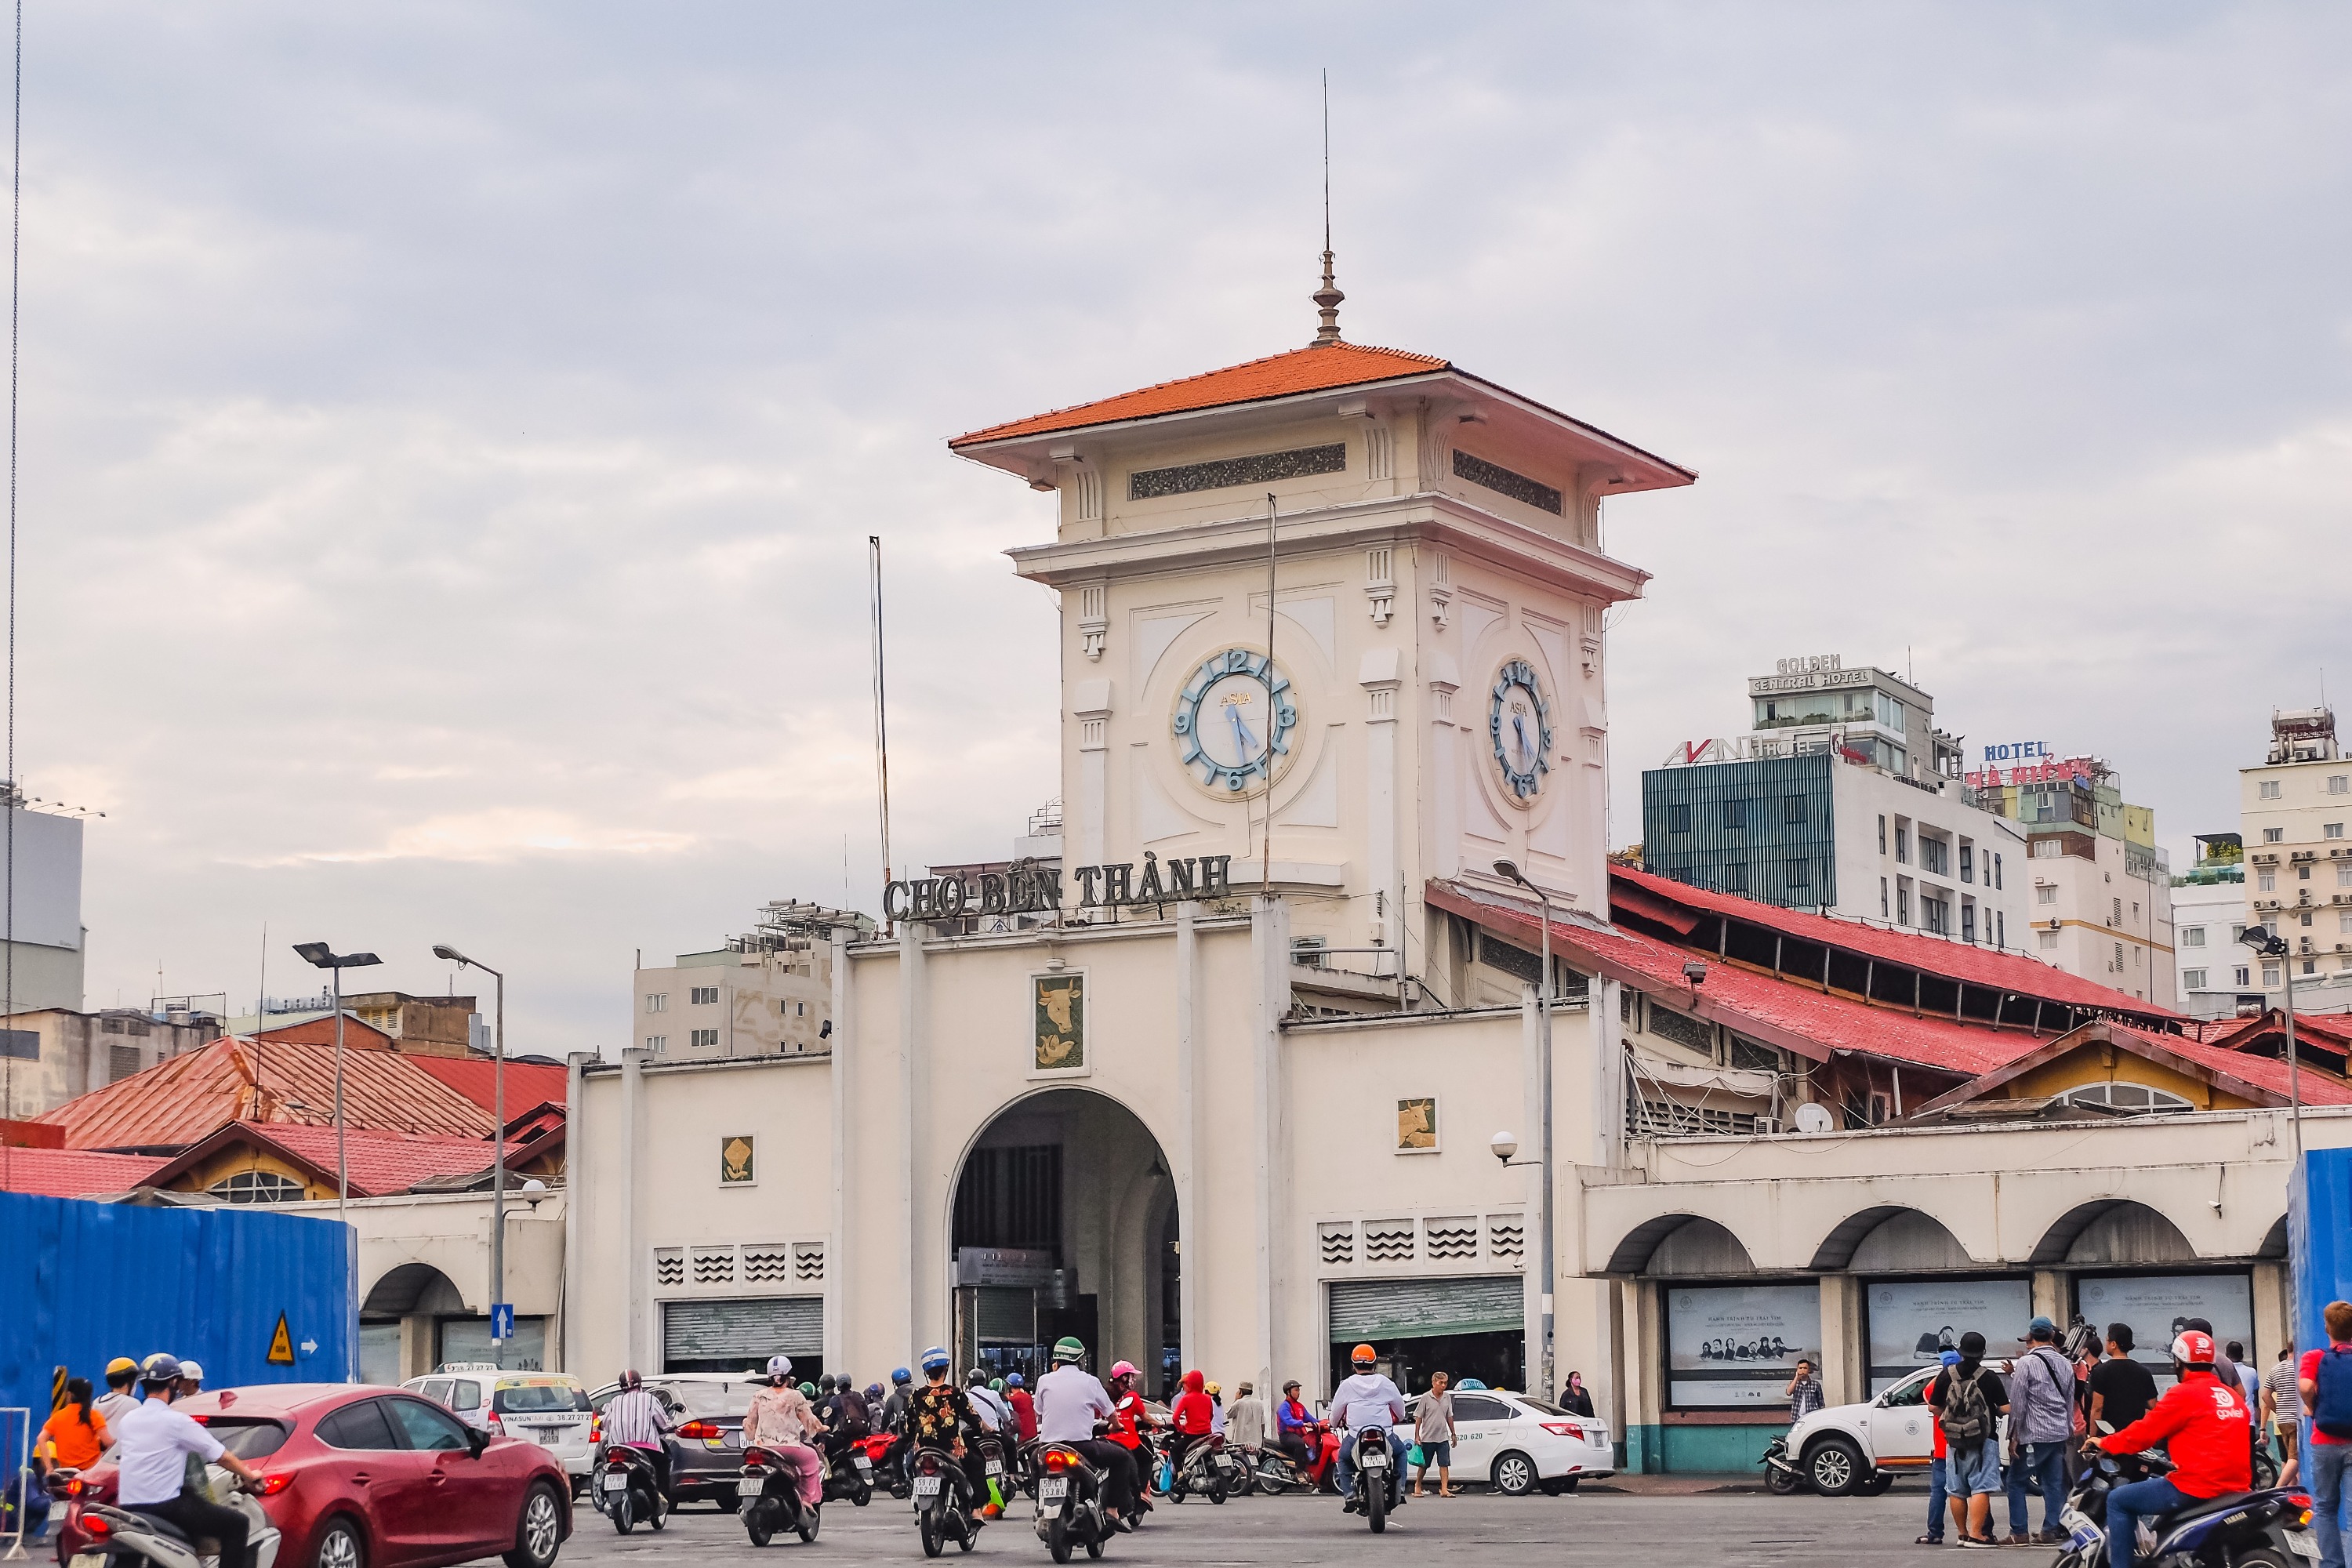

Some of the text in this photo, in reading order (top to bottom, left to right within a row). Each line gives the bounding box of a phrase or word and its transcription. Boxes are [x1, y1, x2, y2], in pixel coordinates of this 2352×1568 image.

[1221, 650, 1247, 673] 12
[1777, 654, 1841, 675] GOLDEN
[1754, 671, 1868, 691] CENTRAL HOTEL
[1220, 692, 1253, 707] ASIA
[1510, 701, 1528, 717] ASIA
[1174, 713, 1190, 734] 9
[1279, 705, 1296, 727] 3
[1490, 714, 1501, 735] 9
[1543, 728, 1554, 749] 3
[1662, 734, 1763, 766] AVANTI
[1767, 739, 1815, 756] HOTEL
[1985, 741, 2047, 761] HOTEL
[1225, 770, 1243, 791] 6
[1518, 777, 1529, 798] 6
[883, 851, 1232, 924] CHỢ BẾN THÀNH
